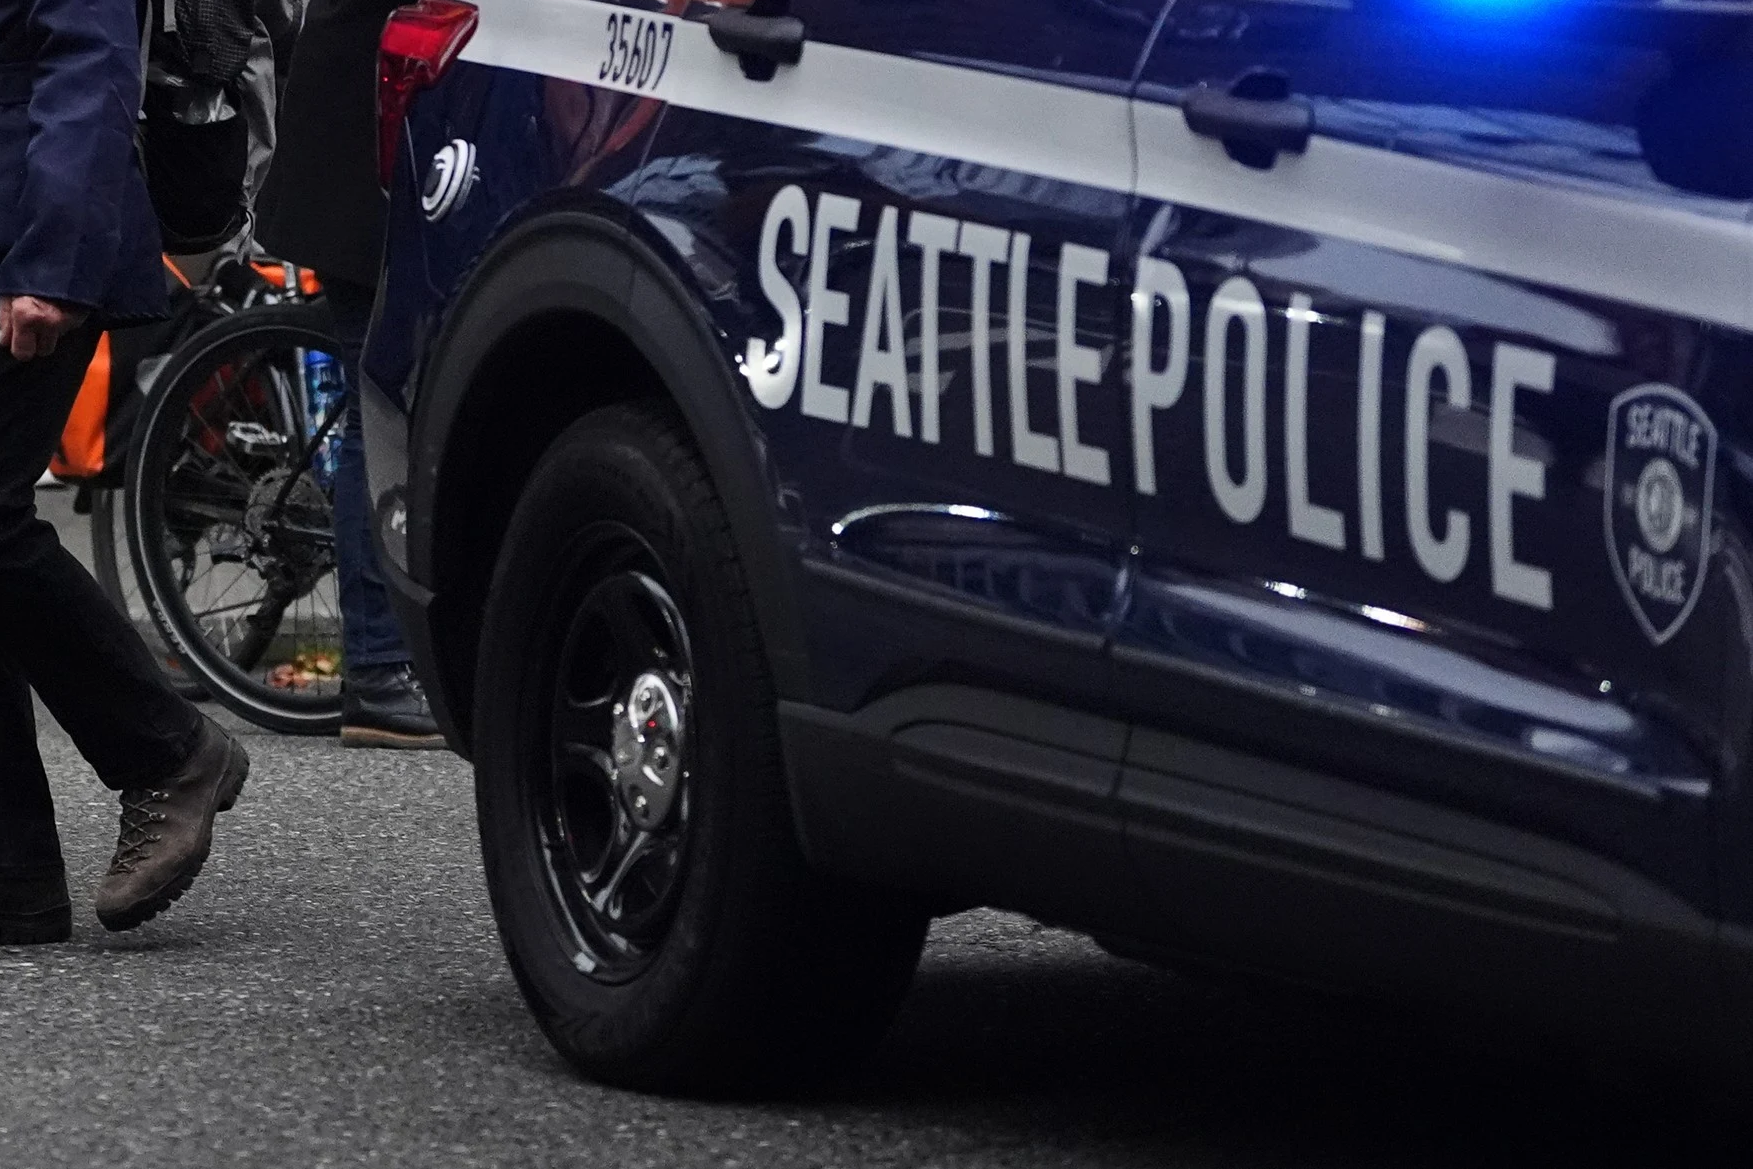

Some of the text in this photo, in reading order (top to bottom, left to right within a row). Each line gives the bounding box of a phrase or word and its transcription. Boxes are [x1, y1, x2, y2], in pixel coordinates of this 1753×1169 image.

[599, 13, 674, 90] 35607
[747, 184, 1556, 610] SEATTLE POLICE
